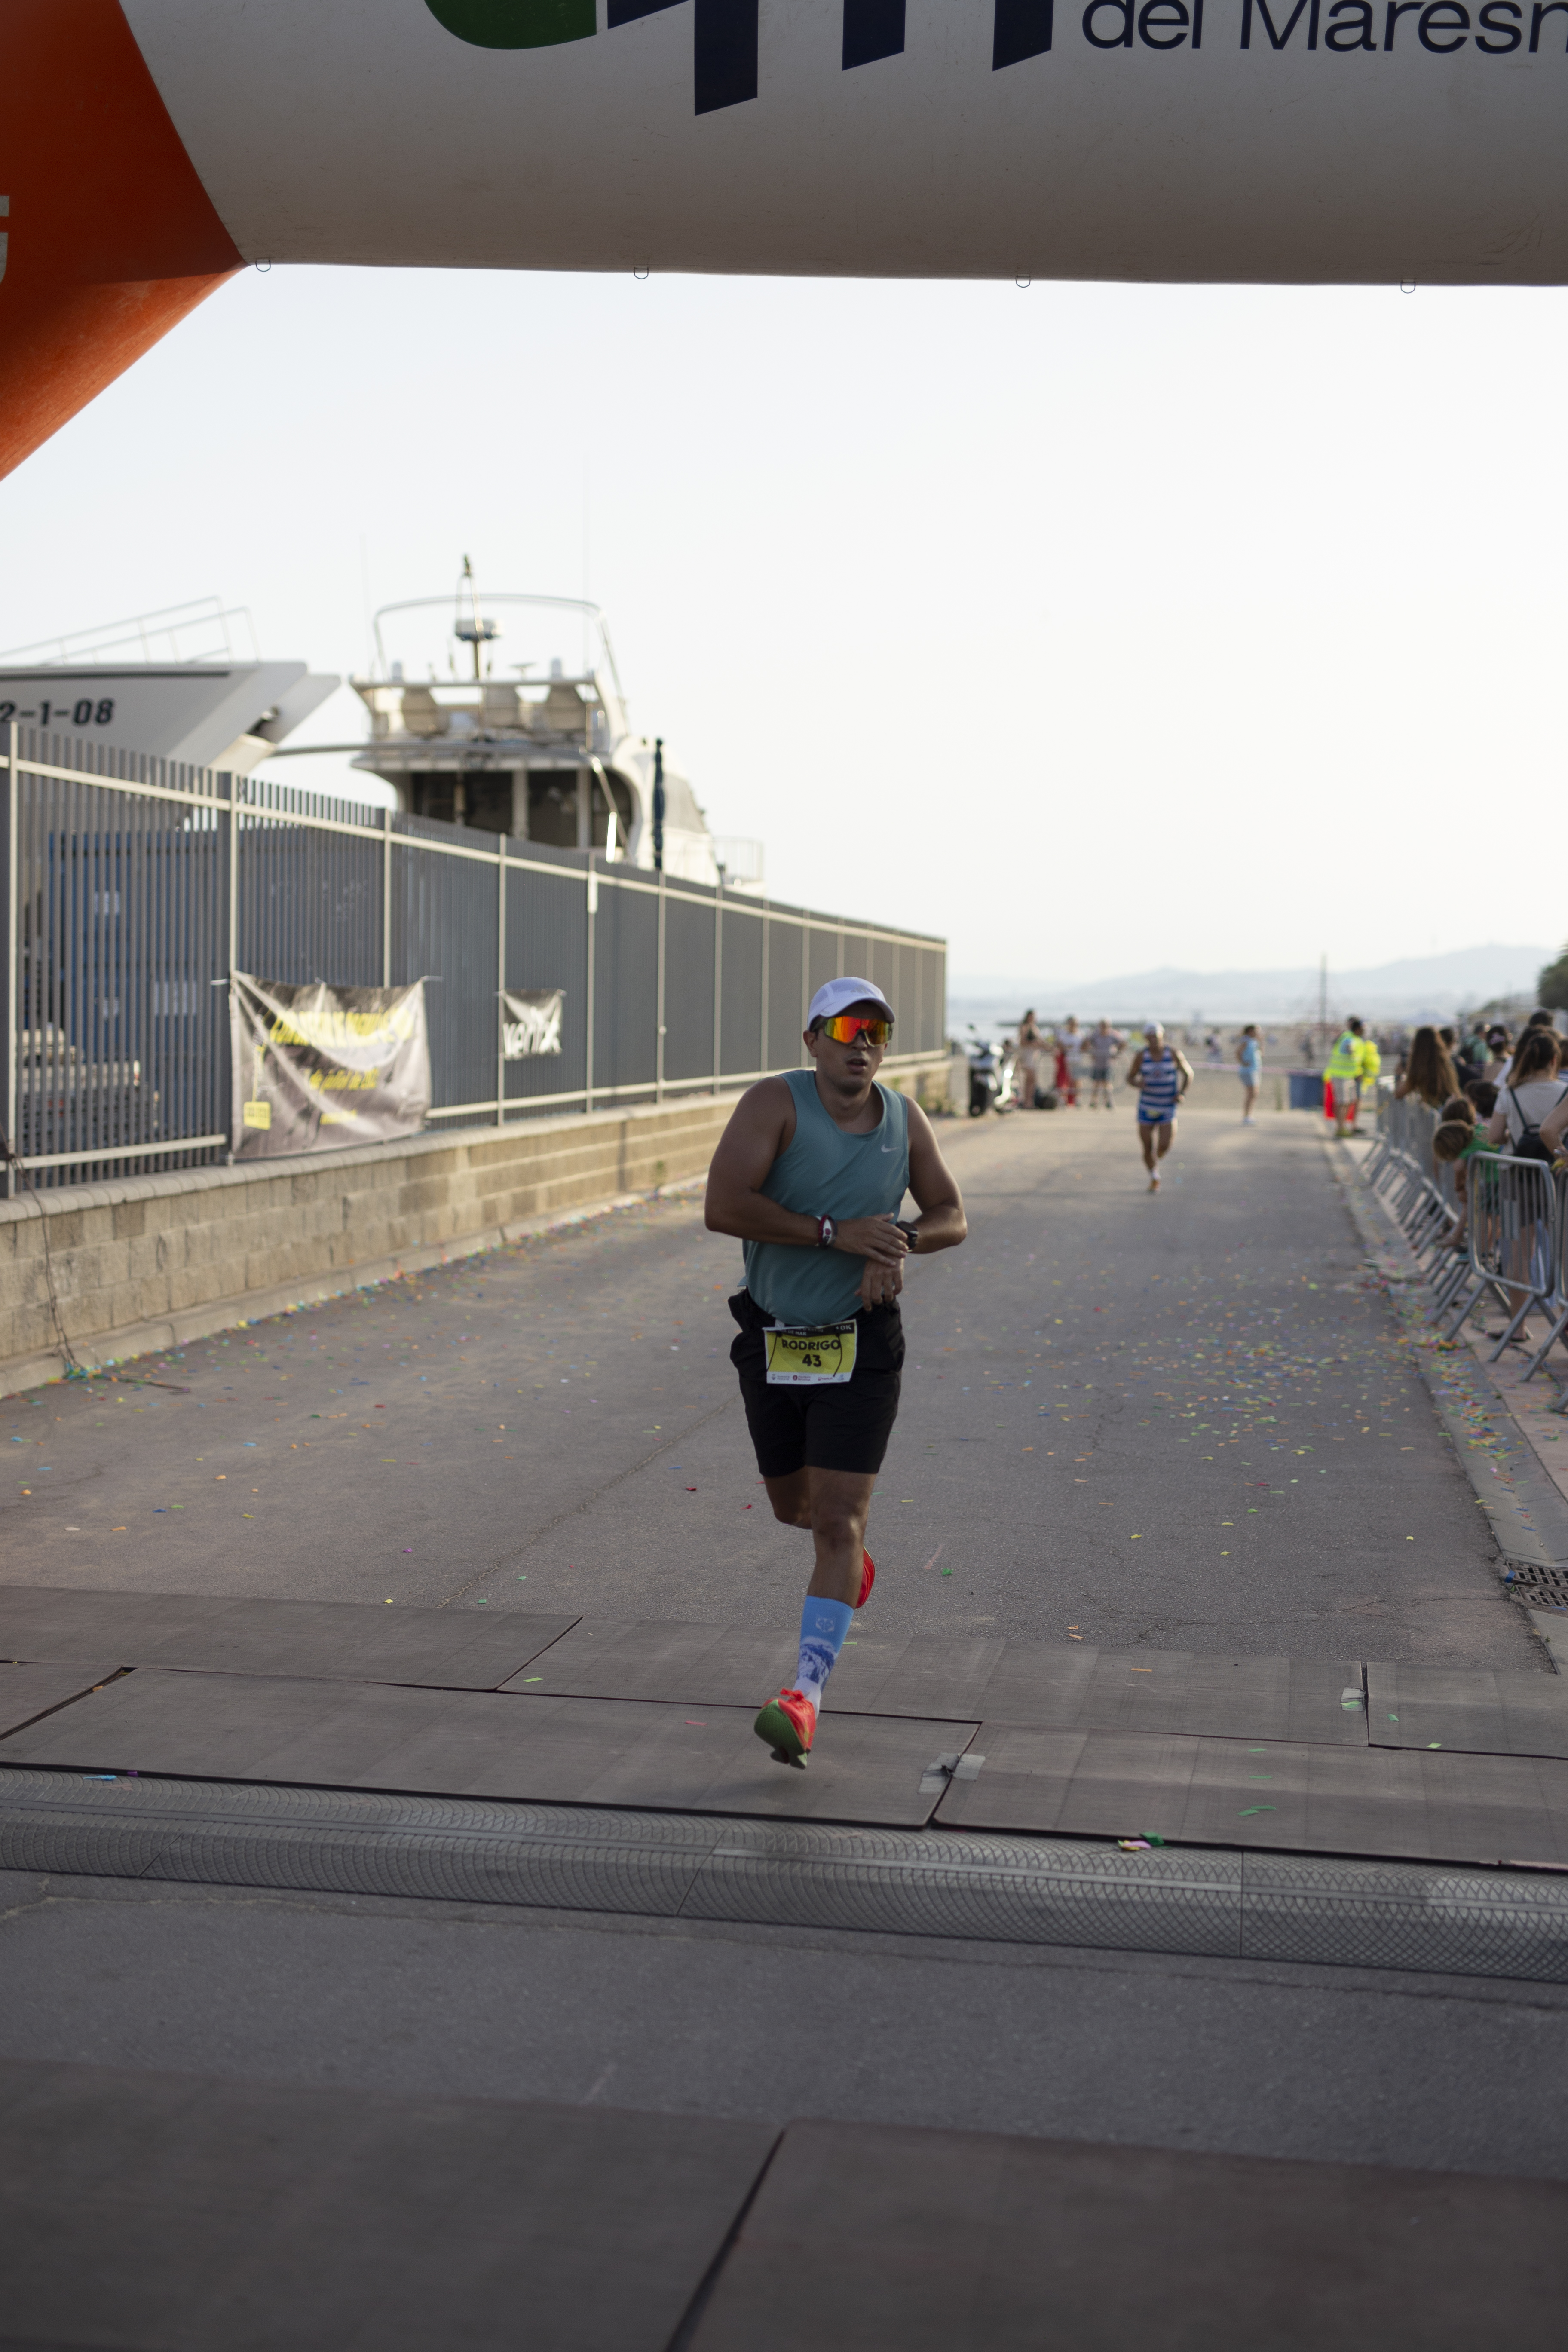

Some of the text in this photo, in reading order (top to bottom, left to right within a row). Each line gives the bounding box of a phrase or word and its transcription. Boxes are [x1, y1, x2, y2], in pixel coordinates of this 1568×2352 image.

[1082, 0, 1204, 50] del
[781, 1338, 841, 1351] RODRIGO
[802, 1354, 822, 1367] 43
